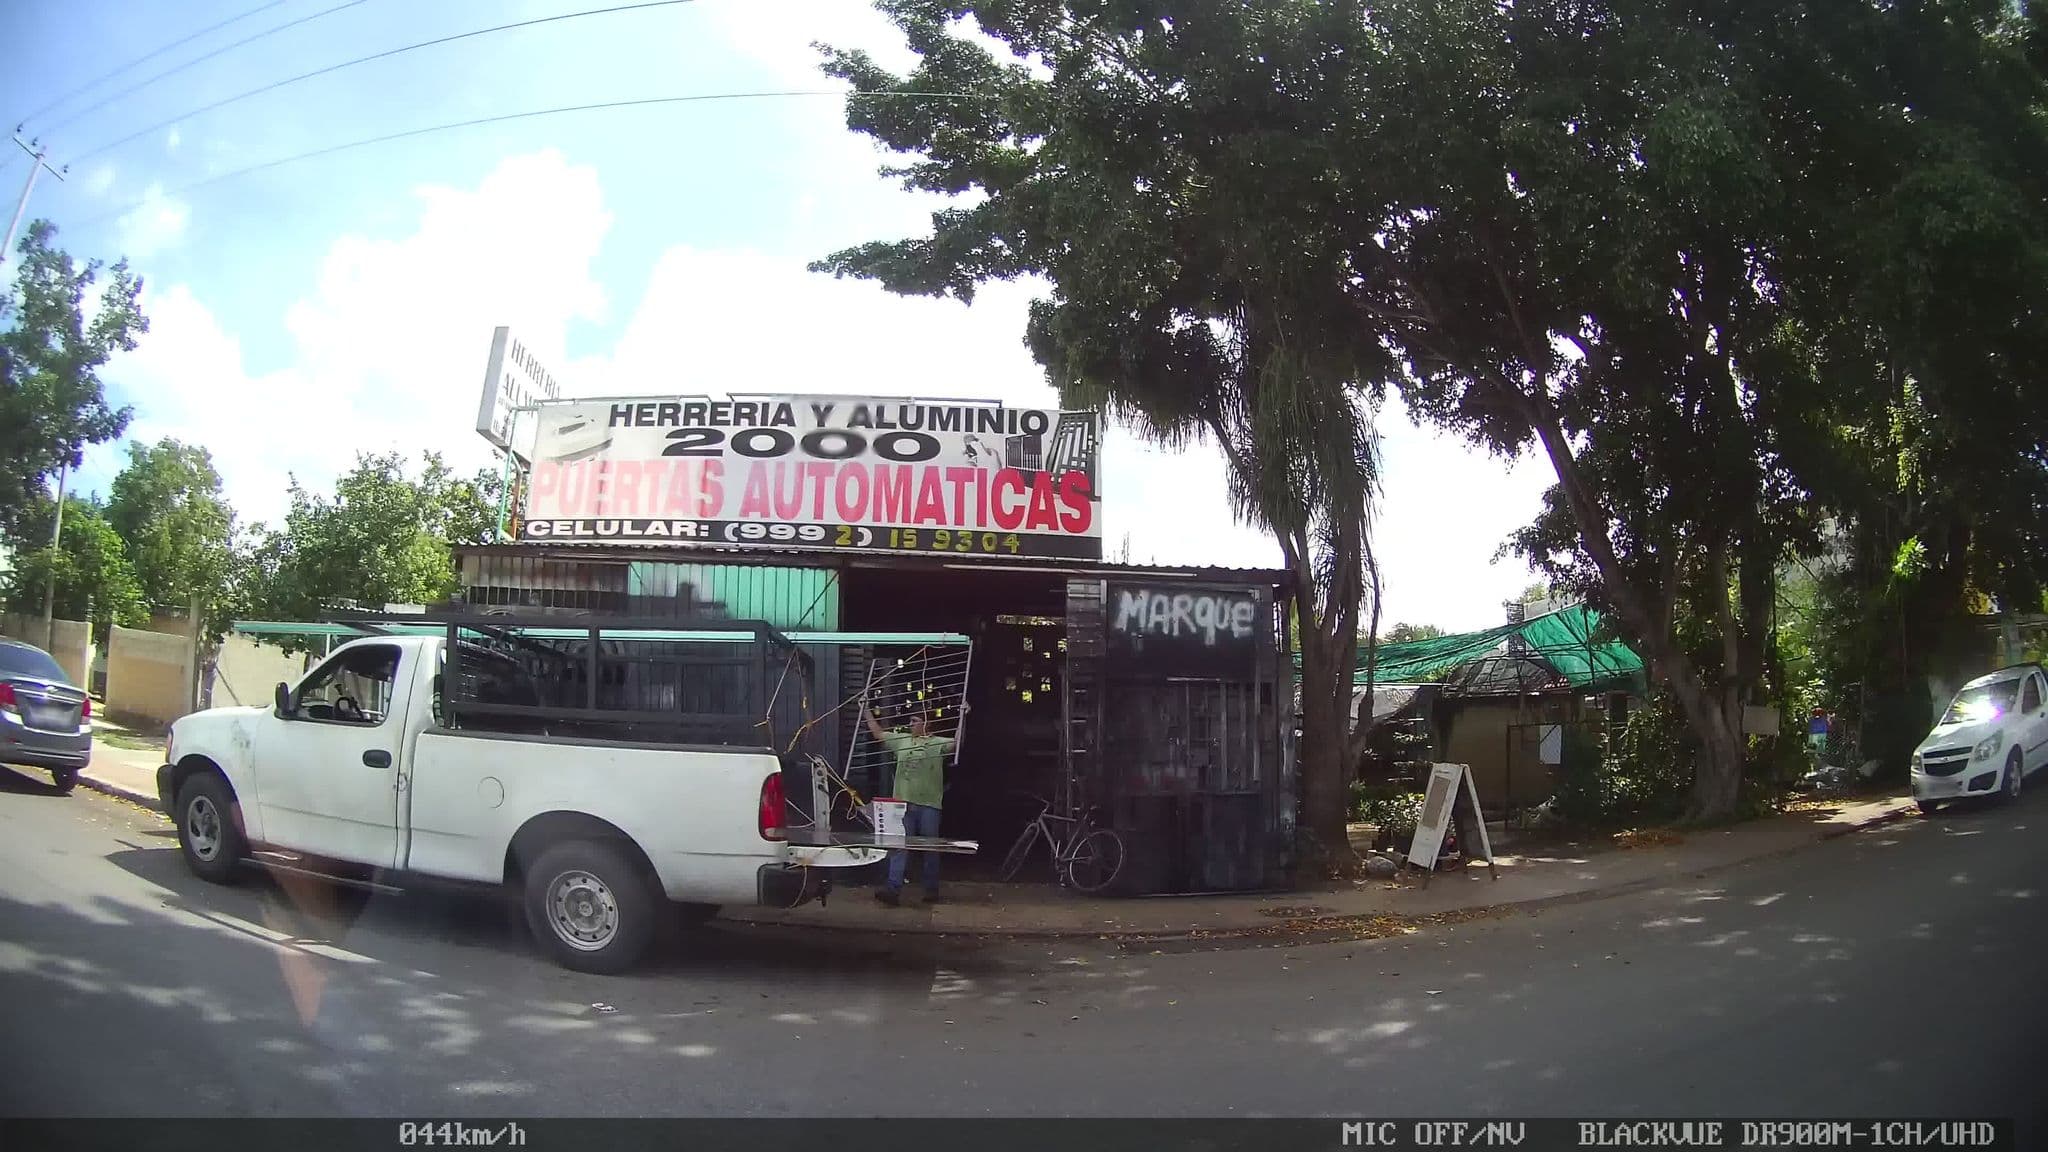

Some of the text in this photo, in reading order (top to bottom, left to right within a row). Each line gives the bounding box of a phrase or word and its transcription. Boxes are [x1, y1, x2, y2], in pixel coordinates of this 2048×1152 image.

[609, 402, 1049, 436] HERRERIA Y ALUMINIO
[662, 427, 942, 462] 2000
[532, 459, 1093, 534] PUERTAS AUTOMATICAS
[527, 520, 711, 538] CELULAR:
[932, 530, 1020, 554] 9304
